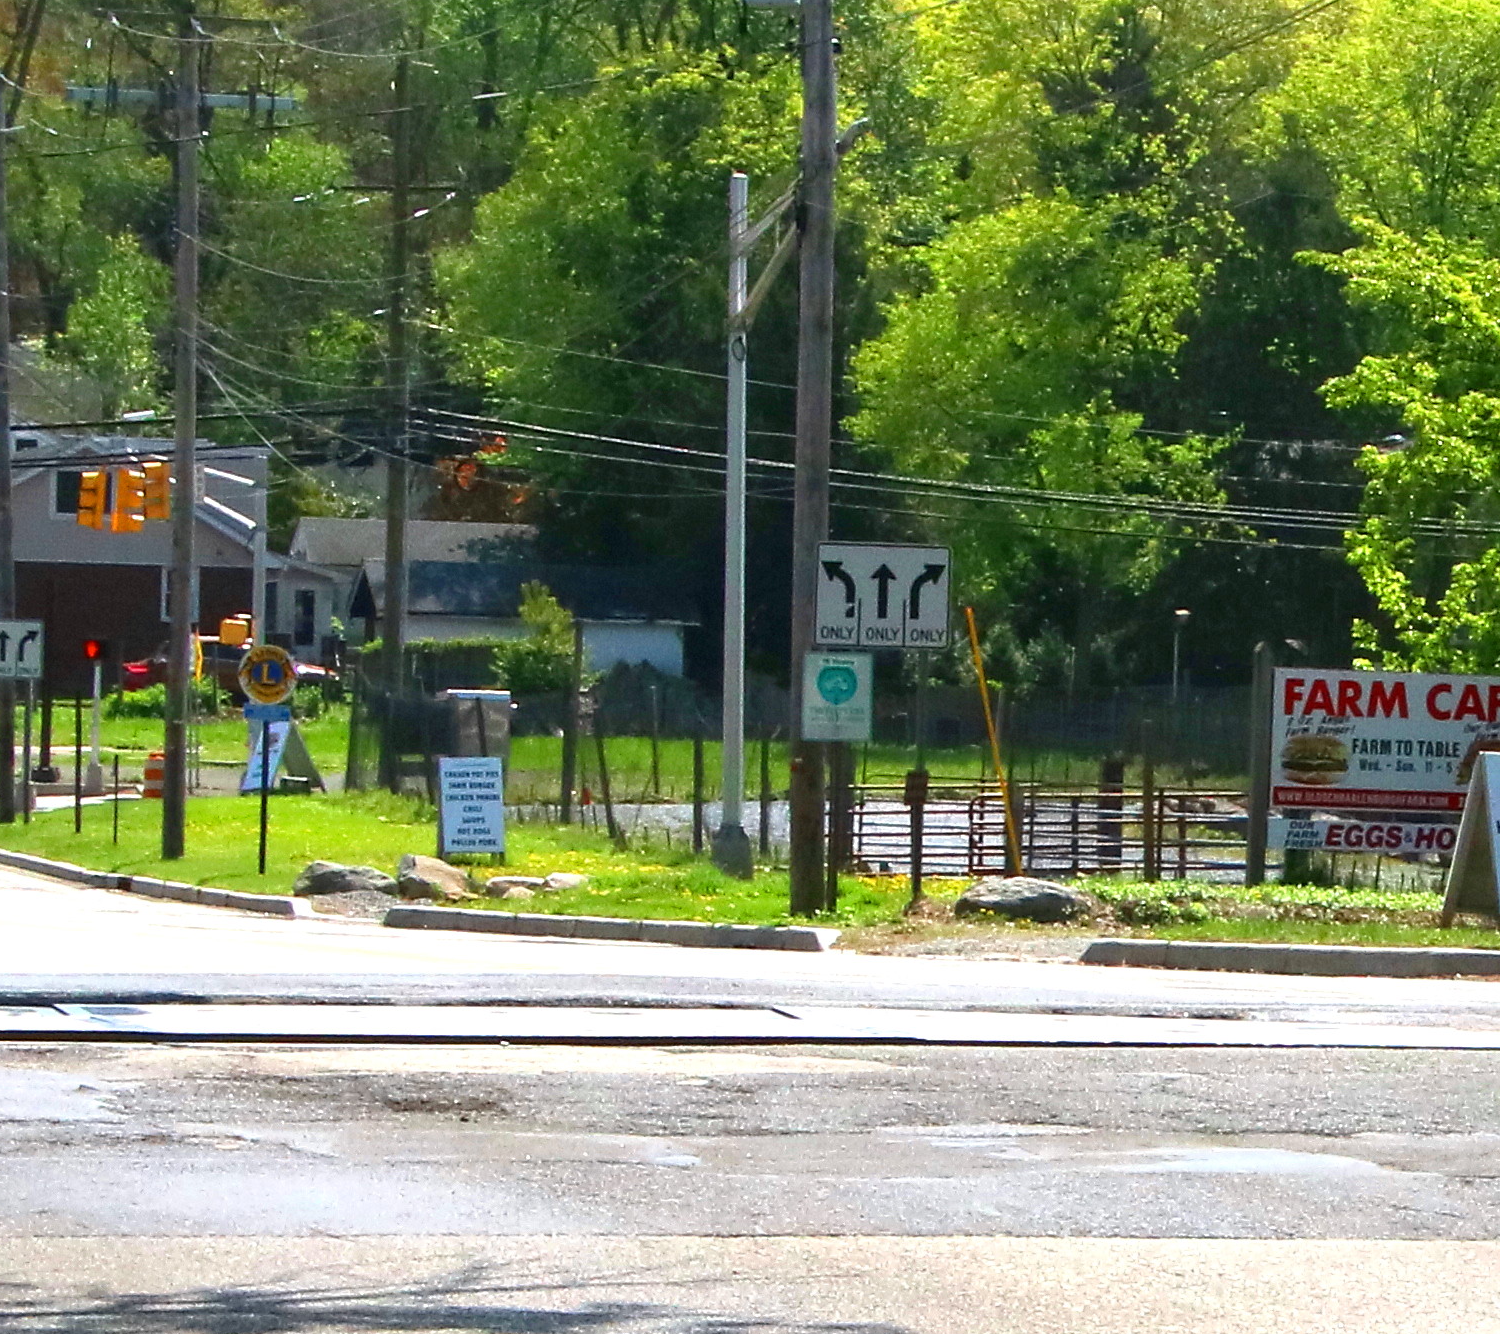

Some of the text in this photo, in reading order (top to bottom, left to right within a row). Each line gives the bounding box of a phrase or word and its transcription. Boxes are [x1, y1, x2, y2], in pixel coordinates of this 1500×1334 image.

[821, 626, 945, 643] ONLY ONLY ONLY
[1284, 678, 1409, 719] FARM
[1352, 738, 1461, 758] FARM TO TABLE
[1287, 829, 1319, 839] FARM
[1325, 824, 1403, 848] EGGS
[1414, 827, 1457, 851] HO
